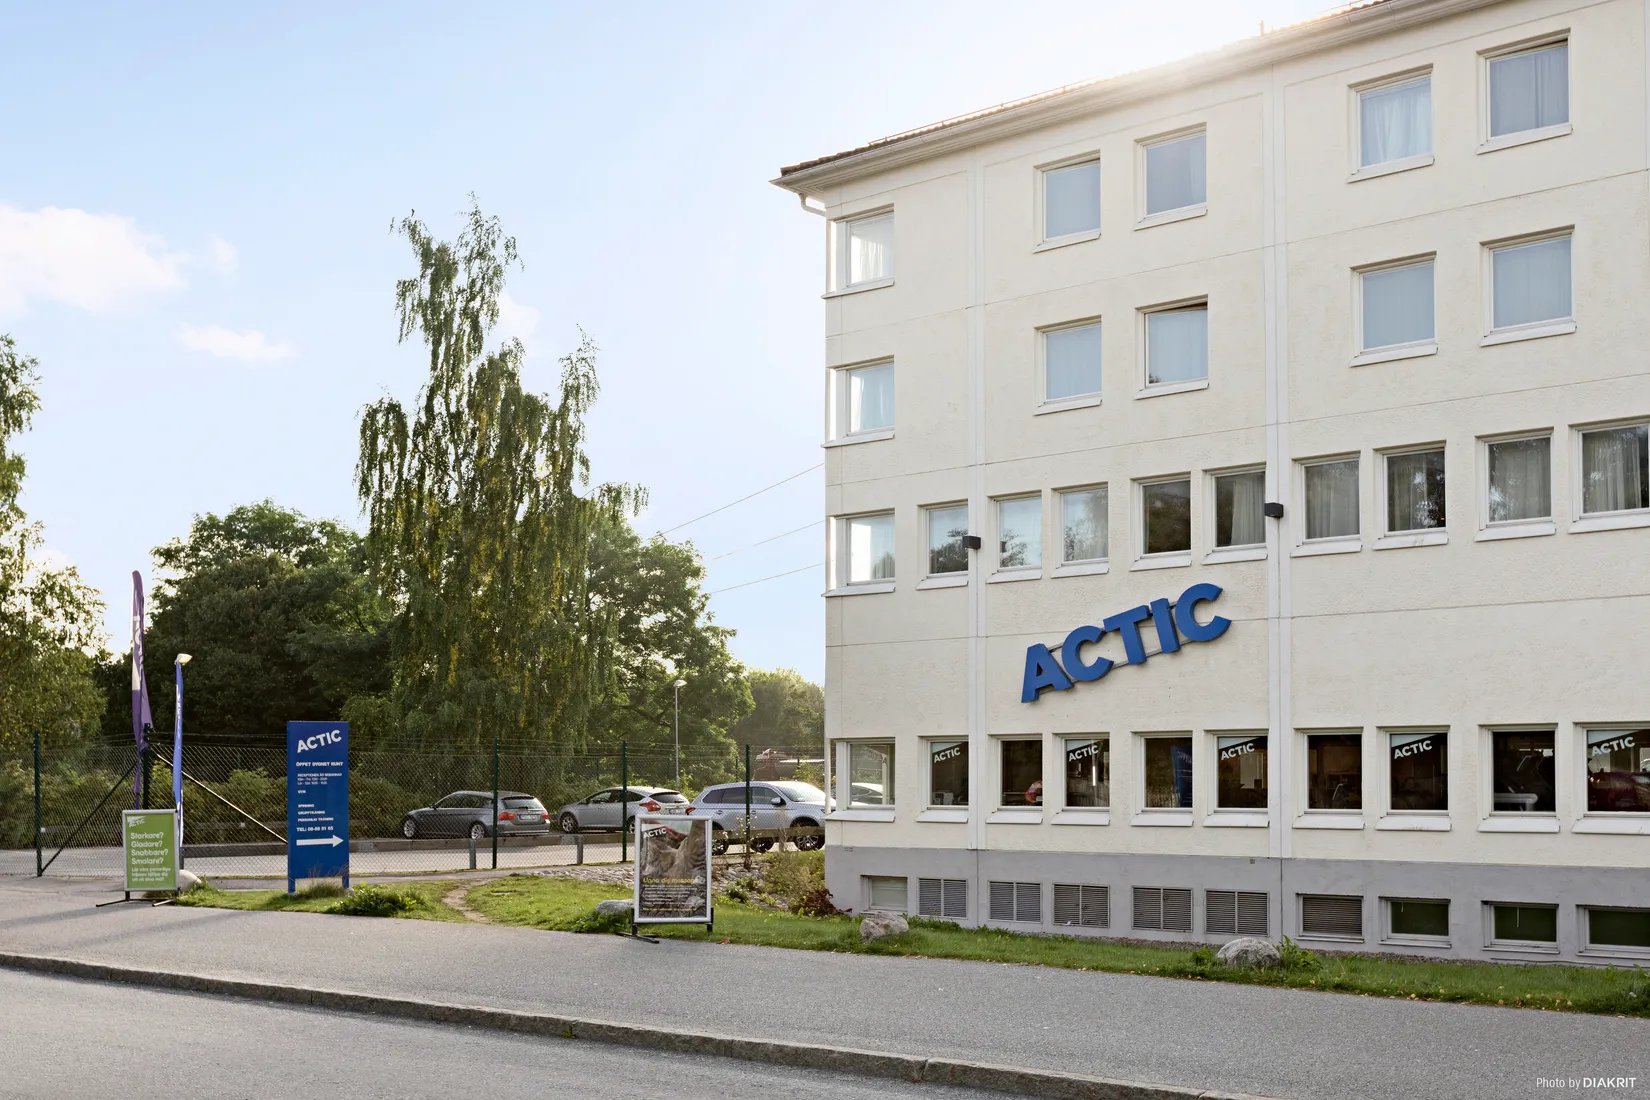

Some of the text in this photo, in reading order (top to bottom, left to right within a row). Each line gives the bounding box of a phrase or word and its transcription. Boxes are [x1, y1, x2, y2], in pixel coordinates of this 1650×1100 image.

[1021, 583, 1232, 703] ACTIC
[297, 729, 342, 753] ACTIC
[1592, 736, 1636, 757] ACTIC
[933, 747, 961, 763] ACTIC
[1068, 745, 1099, 762] ACTIC
[1220, 742, 1255, 761] ACTIC
[1393, 740, 1433, 760] ACTIC
[129, 818, 146, 828] ACTIC
[130, 831, 164, 840] Starkare?
[643, 827, 667, 839] ACTIC
[130, 840, 163, 848] Gladare?
[131, 848, 169, 857] Snabbare?
[131, 857, 164, 865] Smalare?
[660, 877, 671, 885] dig
